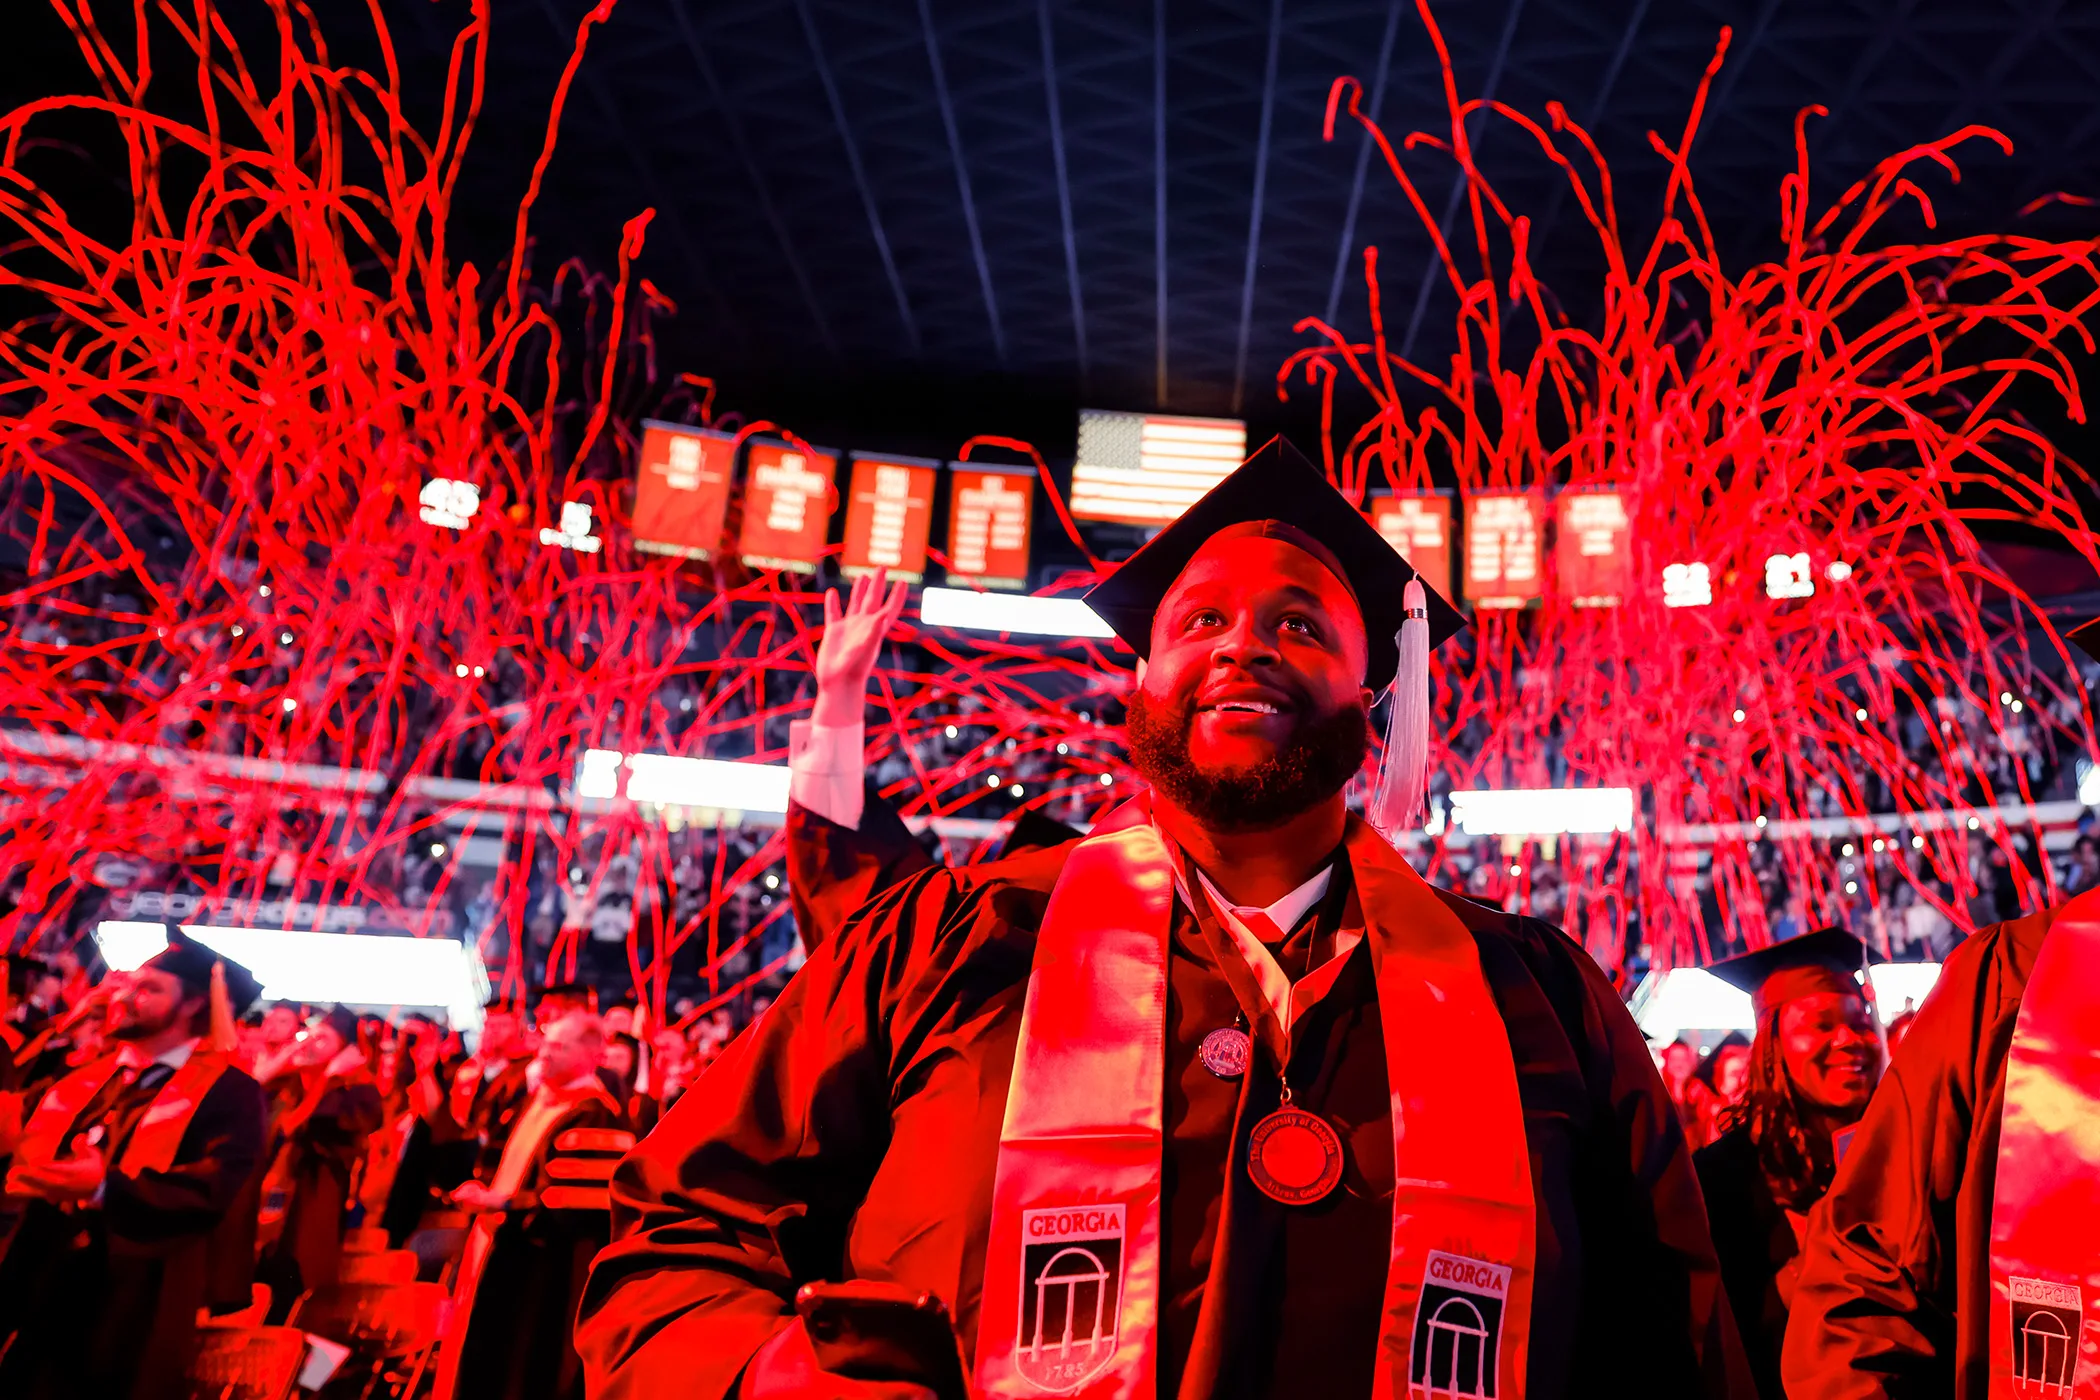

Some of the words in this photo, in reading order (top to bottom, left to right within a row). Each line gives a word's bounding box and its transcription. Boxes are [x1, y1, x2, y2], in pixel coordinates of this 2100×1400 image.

[1255, 1115, 1298, 1142] University
[1299, 1117, 1311, 1127] of
[1310, 1121, 1336, 1156] Georgia
[1029, 1212, 1121, 1237] GEORGIA
[1430, 1257, 1503, 1291] GEORGIA
[2014, 1282, 2079, 1305] GEORGIA
[1045, 1362, 1085, 1382] 1785
